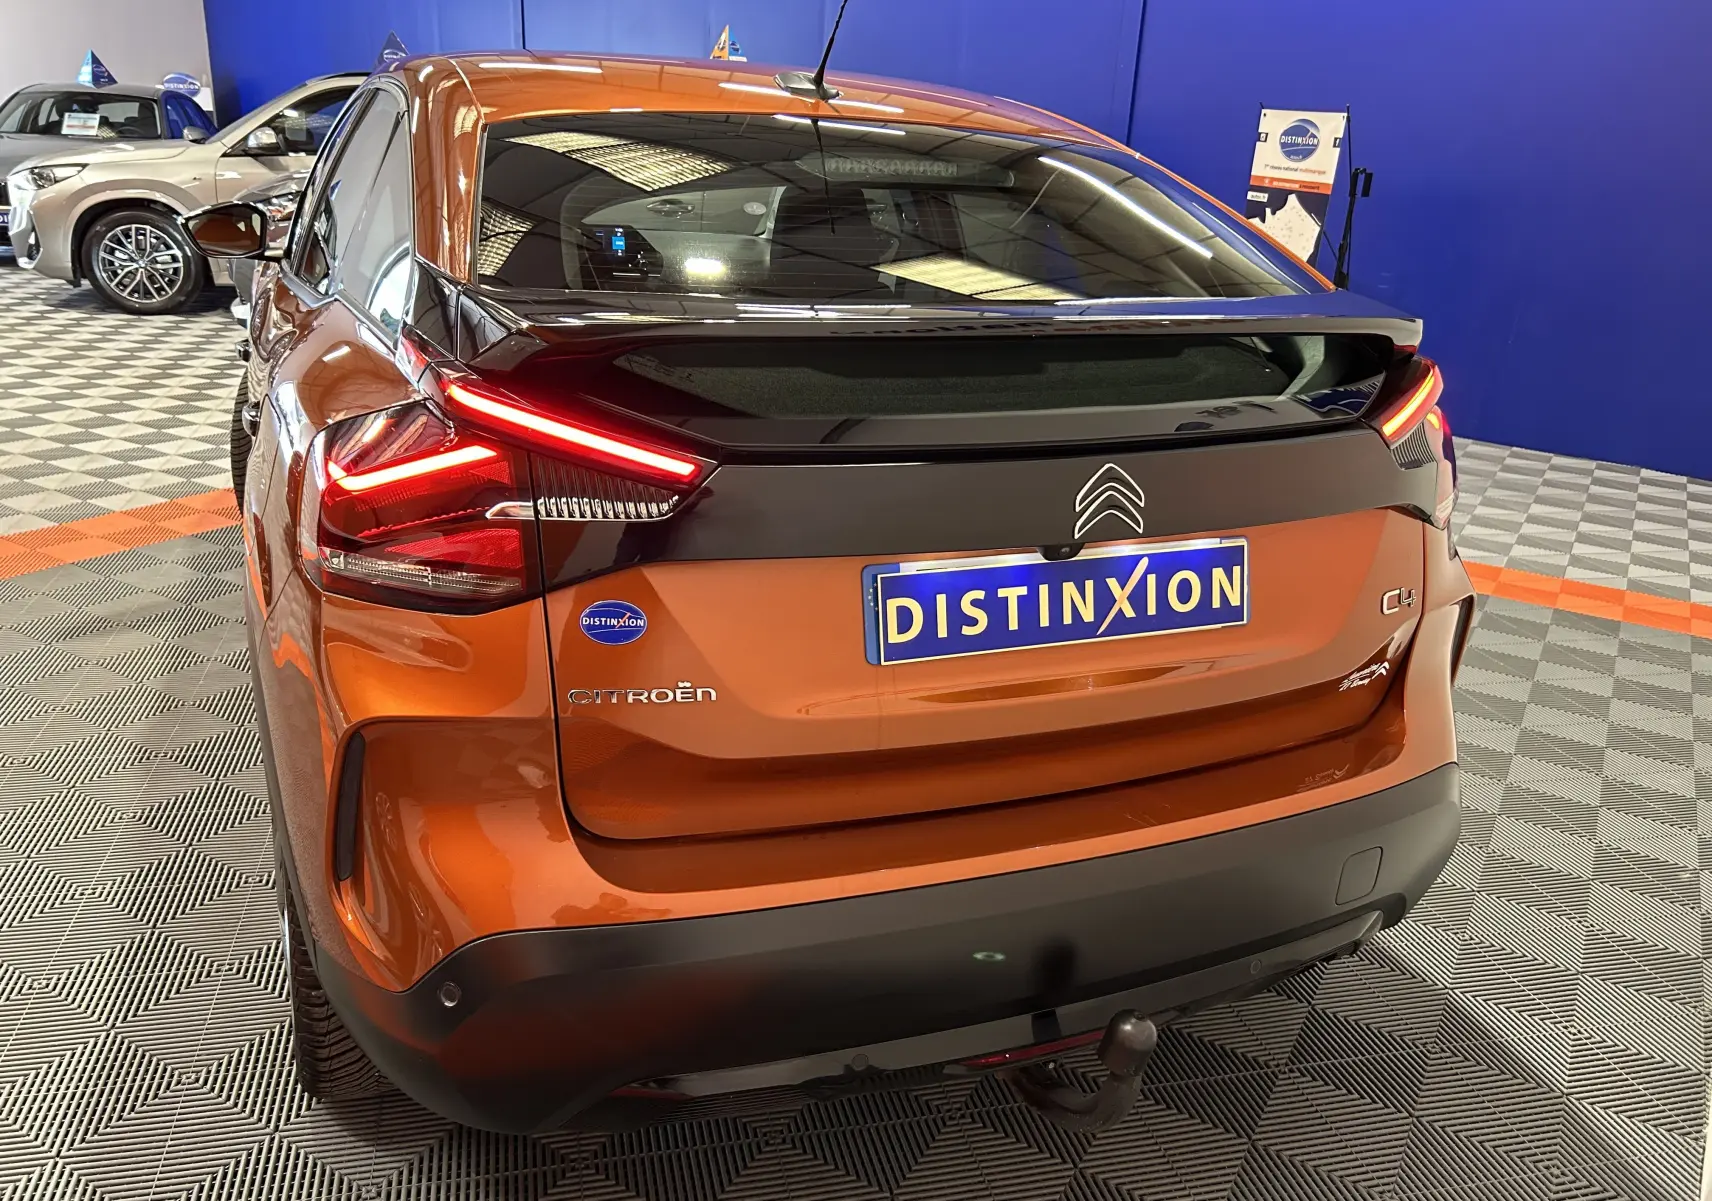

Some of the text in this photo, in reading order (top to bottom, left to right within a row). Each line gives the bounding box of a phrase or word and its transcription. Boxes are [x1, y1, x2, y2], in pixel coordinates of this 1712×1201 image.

[1280, 132, 1319, 146] DISTINXION
[886, 556, 1241, 644] DISTINXION
[1382, 587, 1416, 615] C4
[582, 613, 644, 628] DISTINXION
